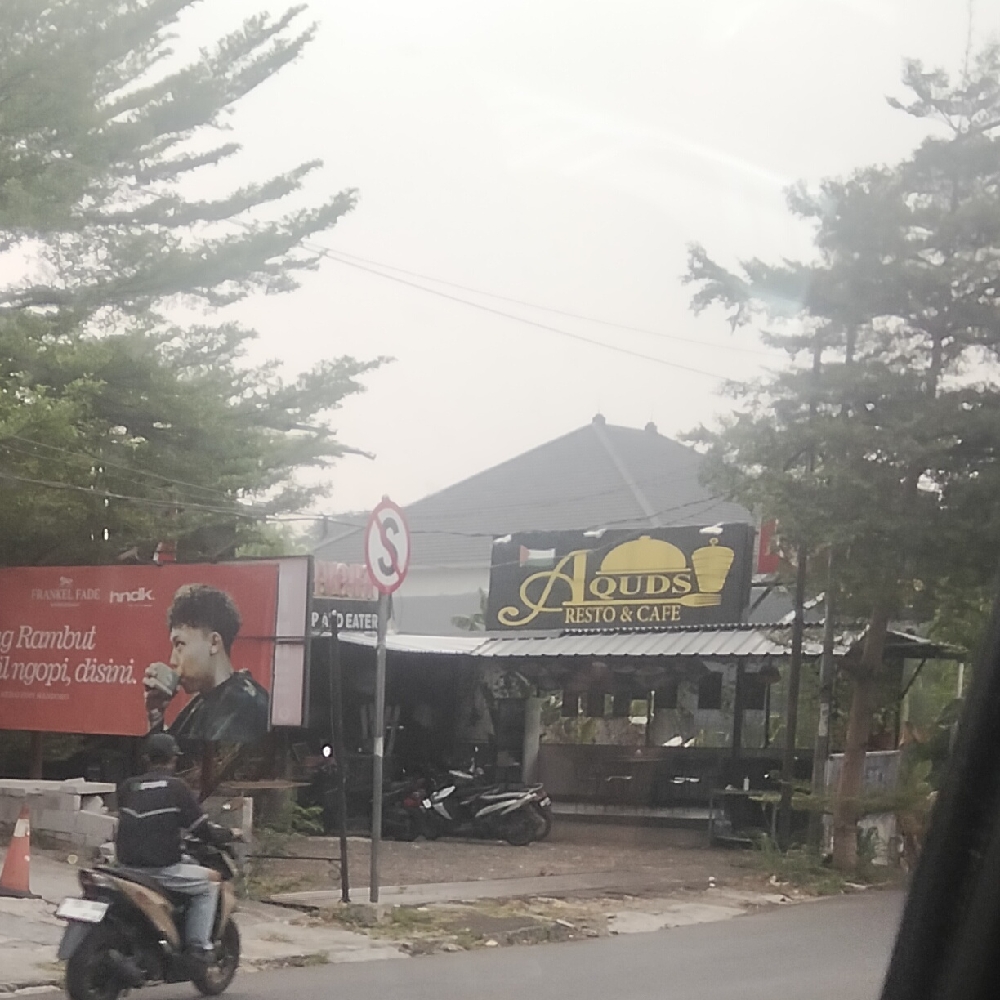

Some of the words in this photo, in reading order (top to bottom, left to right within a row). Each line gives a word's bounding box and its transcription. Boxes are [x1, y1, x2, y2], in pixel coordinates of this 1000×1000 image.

[31, 588, 74, 600] FRANKEL
[75, 588, 101, 600] FADE
[322, 612, 344, 628] AD
[346, 613, 378, 628] EATER
[564, 605, 616, 624] RESTO
[620, 606, 633, 622] &
[637, 604, 682, 621] CAFE
[16, 625, 97, 650] Rambut
[11, 657, 72, 686] ngopi,
[74, 657, 137, 684] disini.
